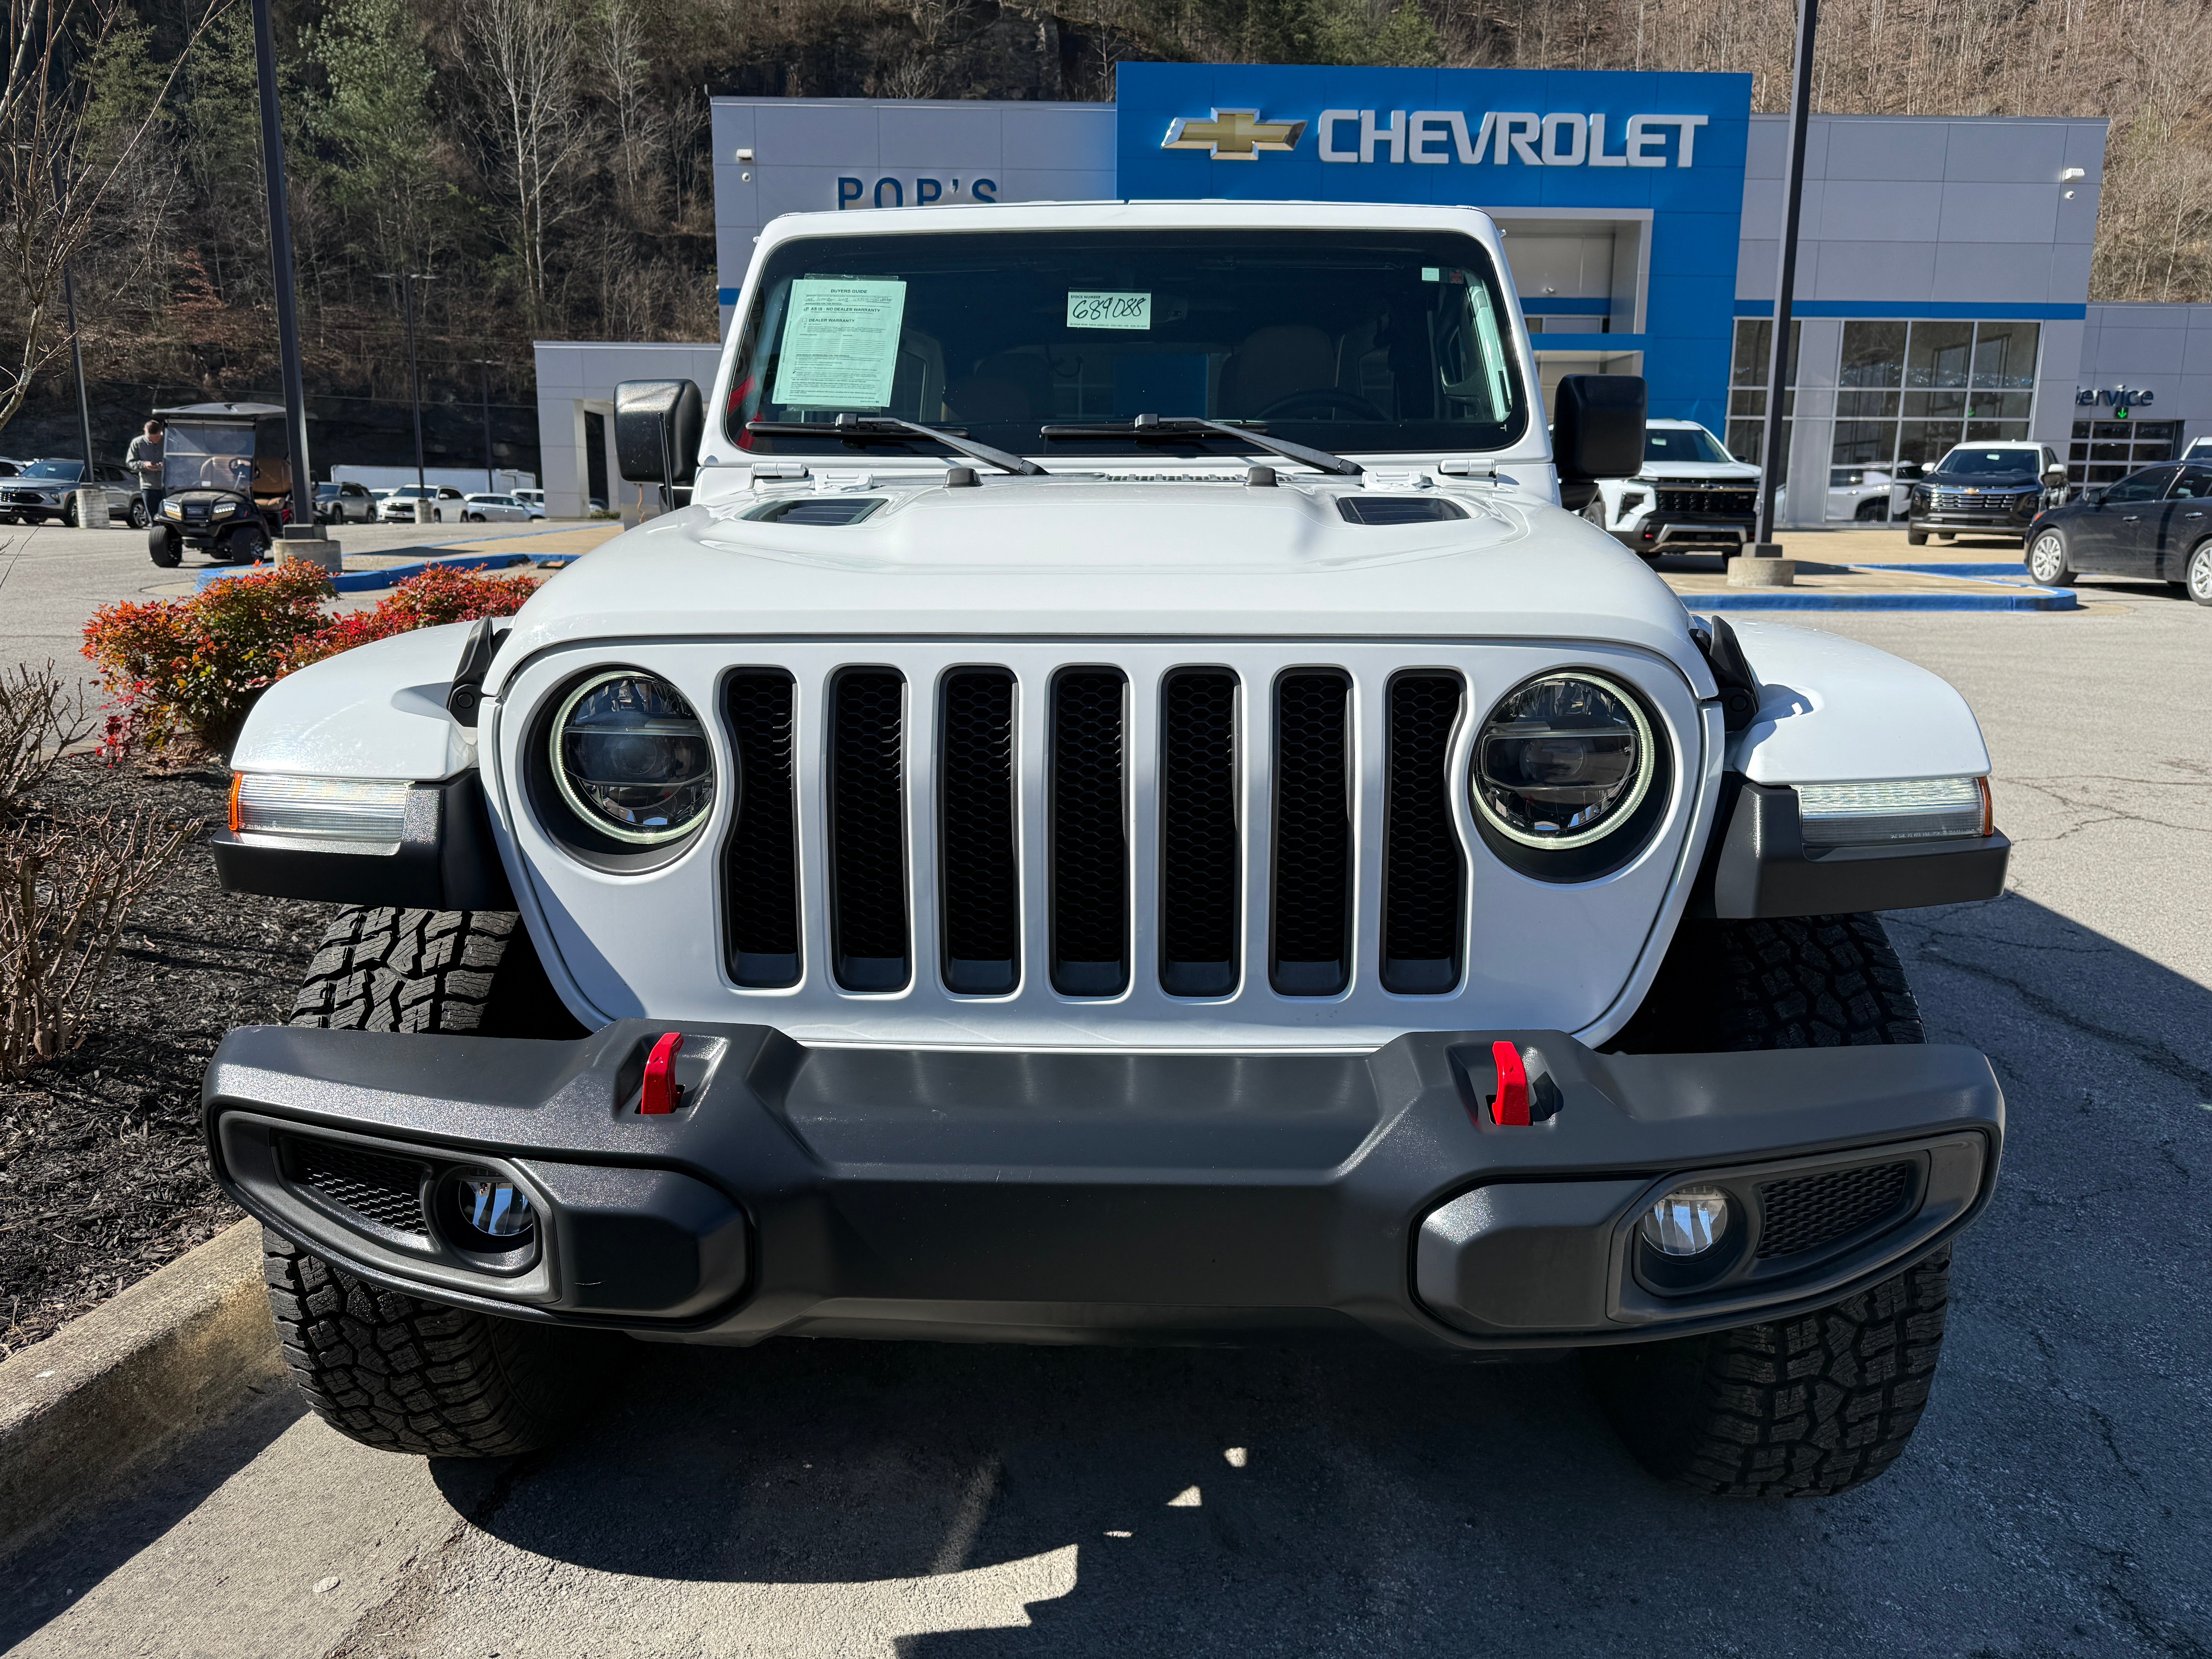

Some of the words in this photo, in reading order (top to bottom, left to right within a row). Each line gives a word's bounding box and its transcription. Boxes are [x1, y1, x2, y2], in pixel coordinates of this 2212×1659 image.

[1318, 110, 1708, 168] CHEVROLET
[838, 177, 997, 210] POP'S
[1073, 297, 1146, 320] 689088
[2075, 384, 2154, 406] ervice
